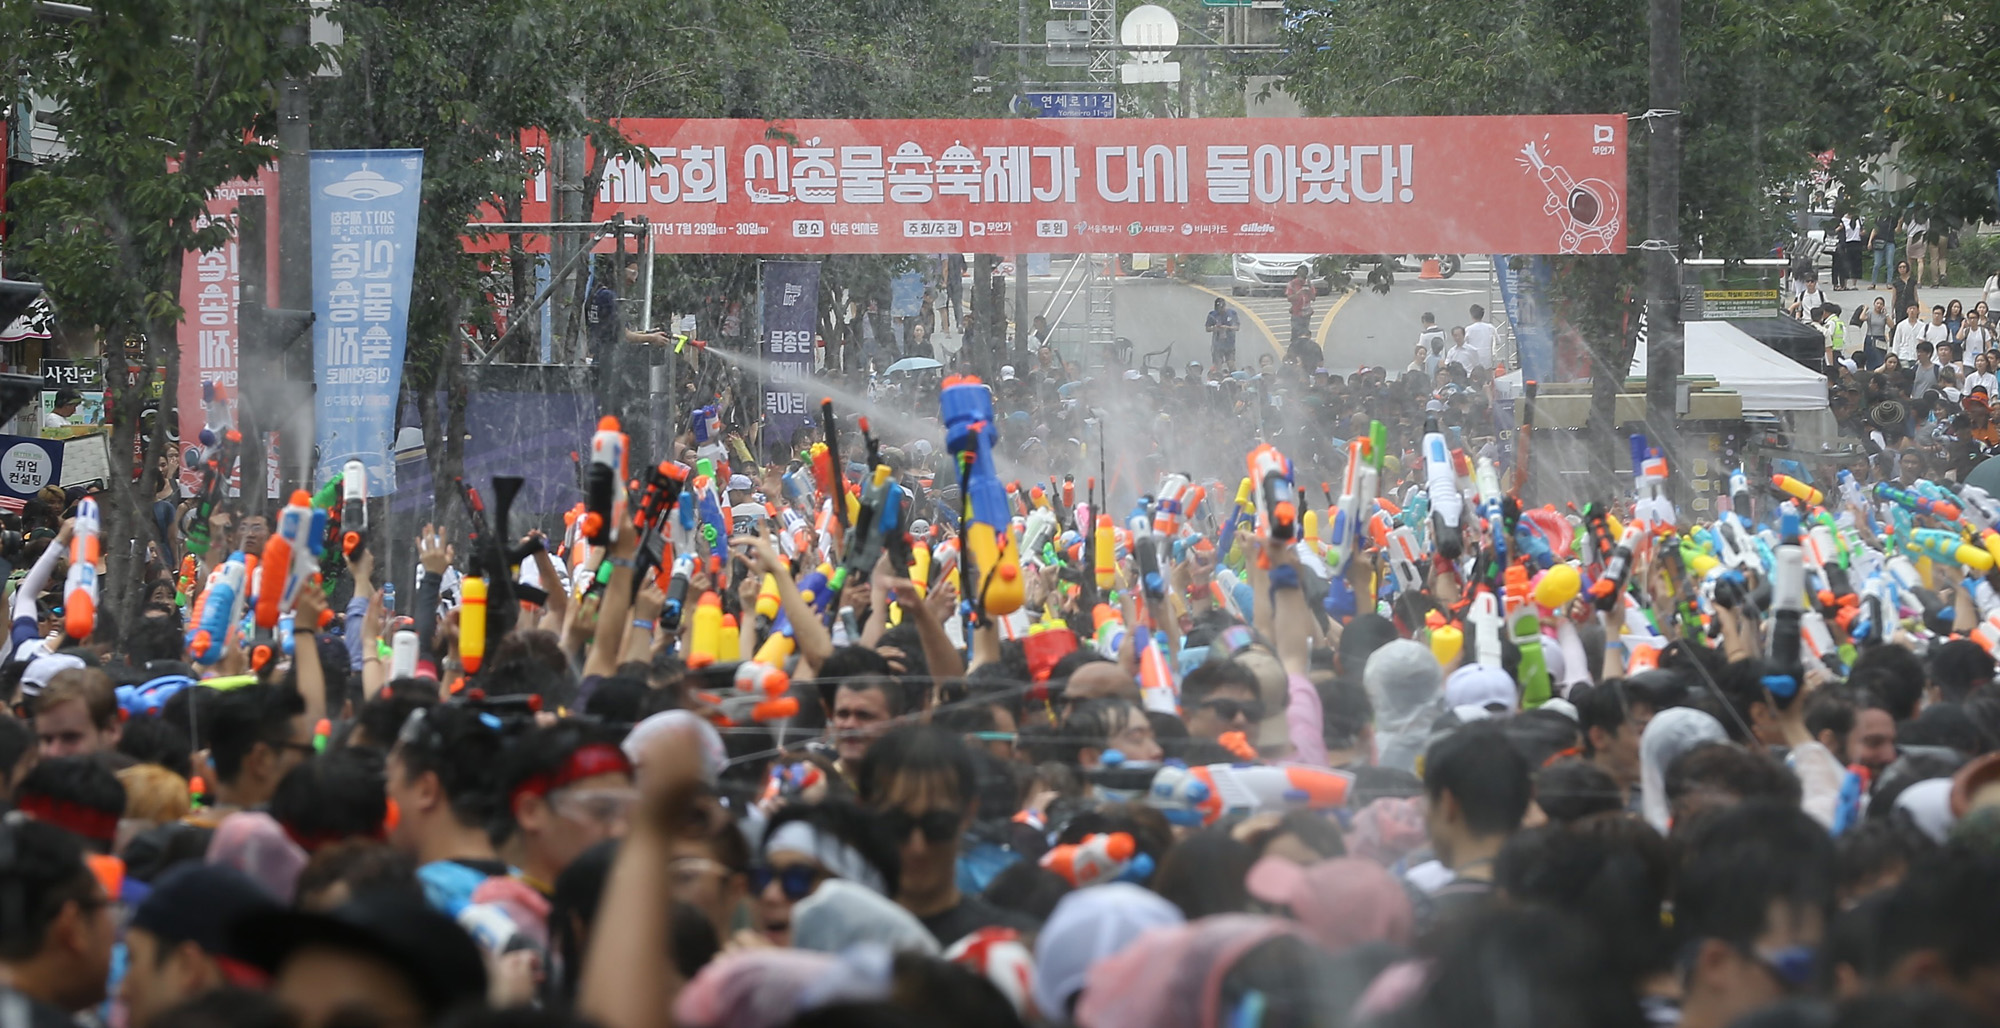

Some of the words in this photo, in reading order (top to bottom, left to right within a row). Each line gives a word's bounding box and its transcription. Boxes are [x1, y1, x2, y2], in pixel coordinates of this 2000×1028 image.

[1041, 95, 1112, 108] 연세로11길
[600, 145, 727, 203] 제5회
[1096, 144, 1188, 203] 다시
[1206, 143, 1414, 203] 돌아왔다!
[648, 222, 673, 235] 17년
[676, 222, 692, 235] 7월
[1144, 223, 1175, 234] 서대문구
[1194, 224, 1229, 234] 비씨카드
[1240, 223, 1275, 232] Gillette
[770, 331, 811, 353] 물총은
[770, 361, 811, 384] 언제나
[15, 460, 38, 473] 취업
[9, 472, 42, 486] 컨설팅
